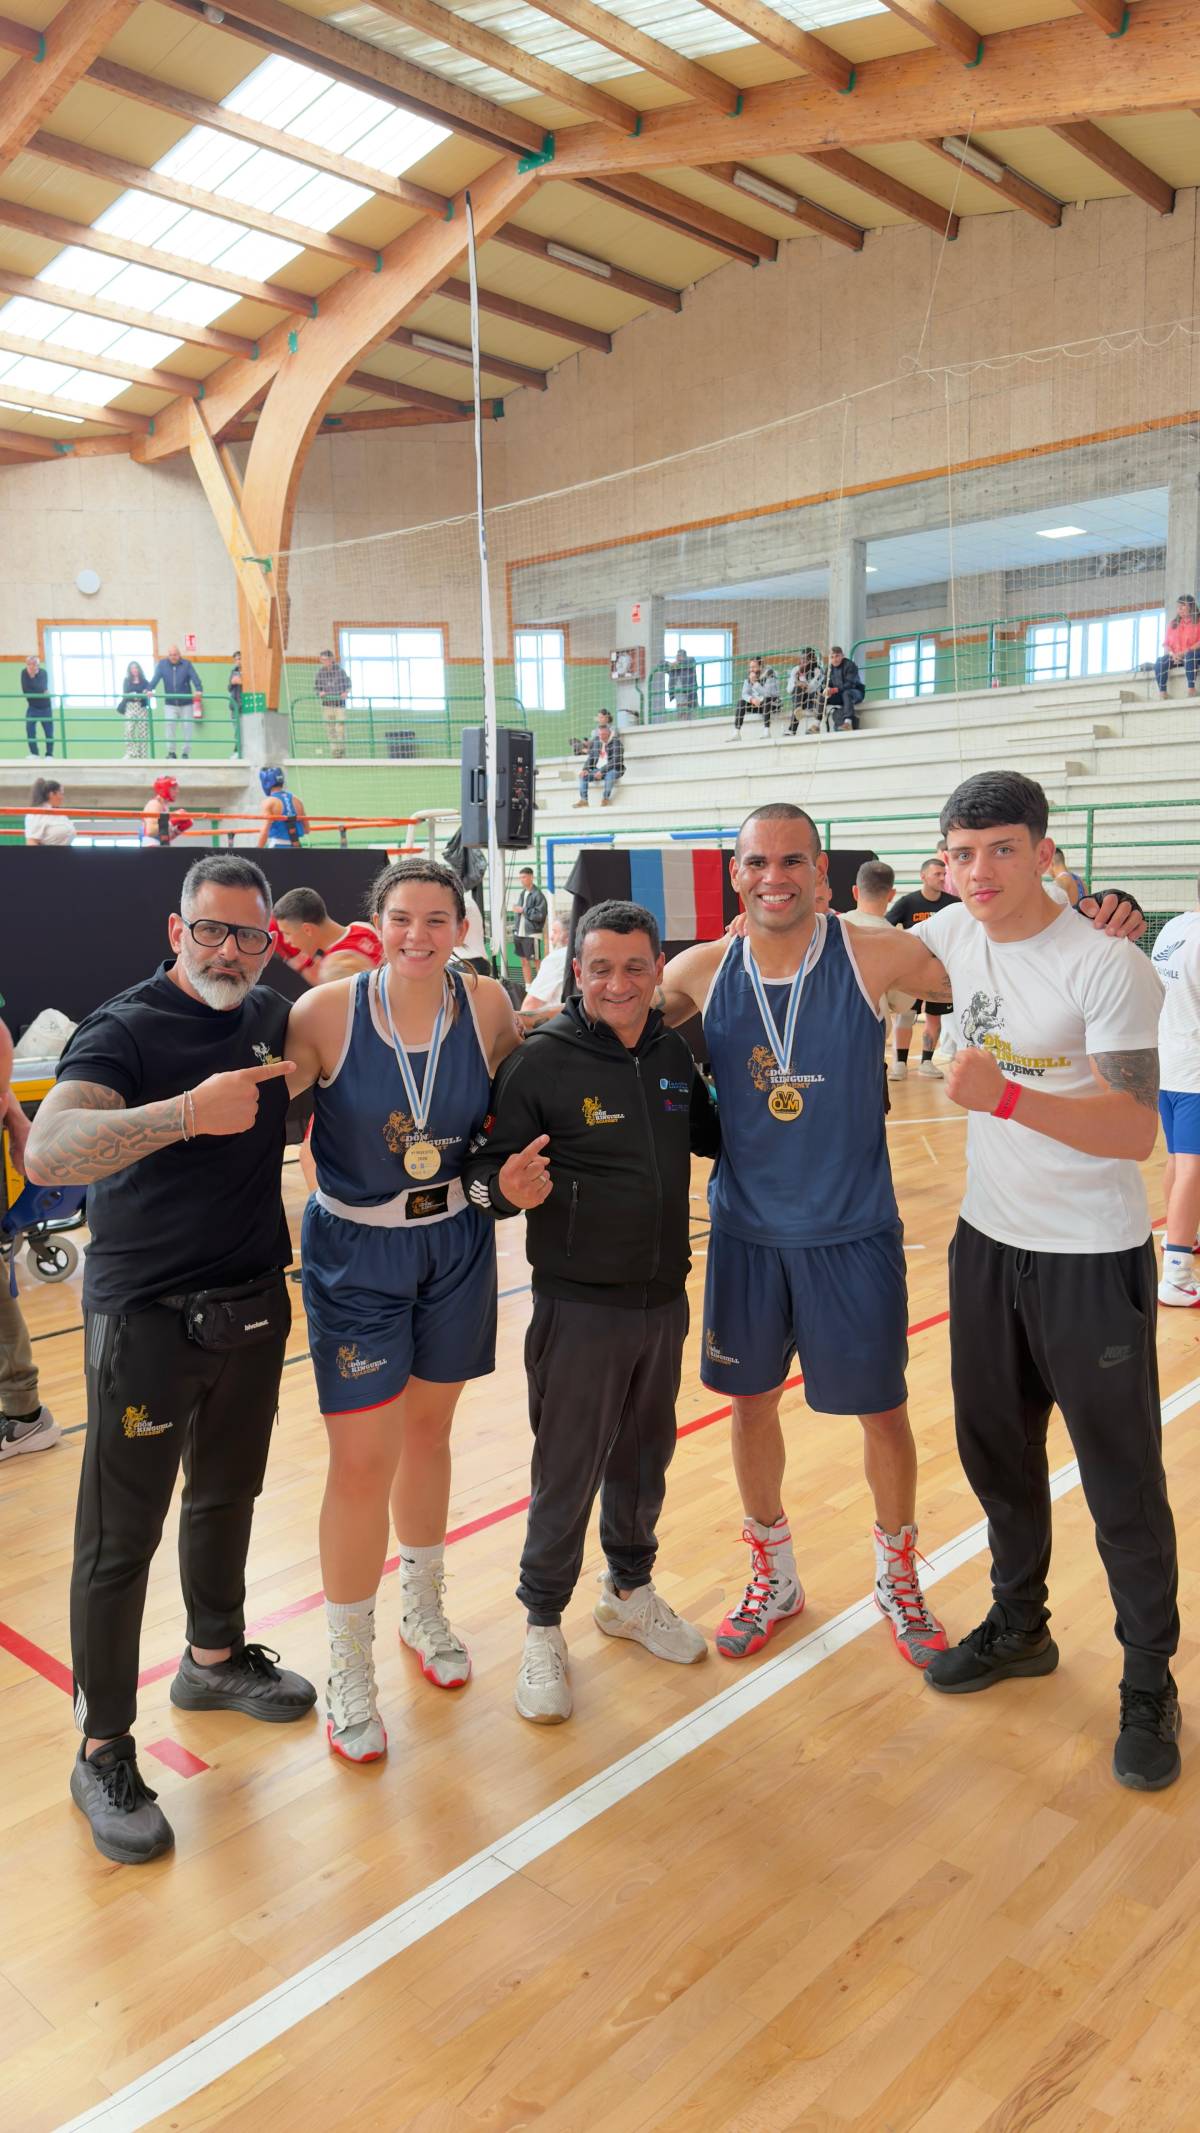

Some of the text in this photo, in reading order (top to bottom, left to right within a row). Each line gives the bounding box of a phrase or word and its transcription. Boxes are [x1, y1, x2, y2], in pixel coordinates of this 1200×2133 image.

[998, 1061, 1046, 1076] ADEMY
[770, 1074, 825, 1084] KINGUELL
[1104, 1345, 1131, 1359] NIKE
